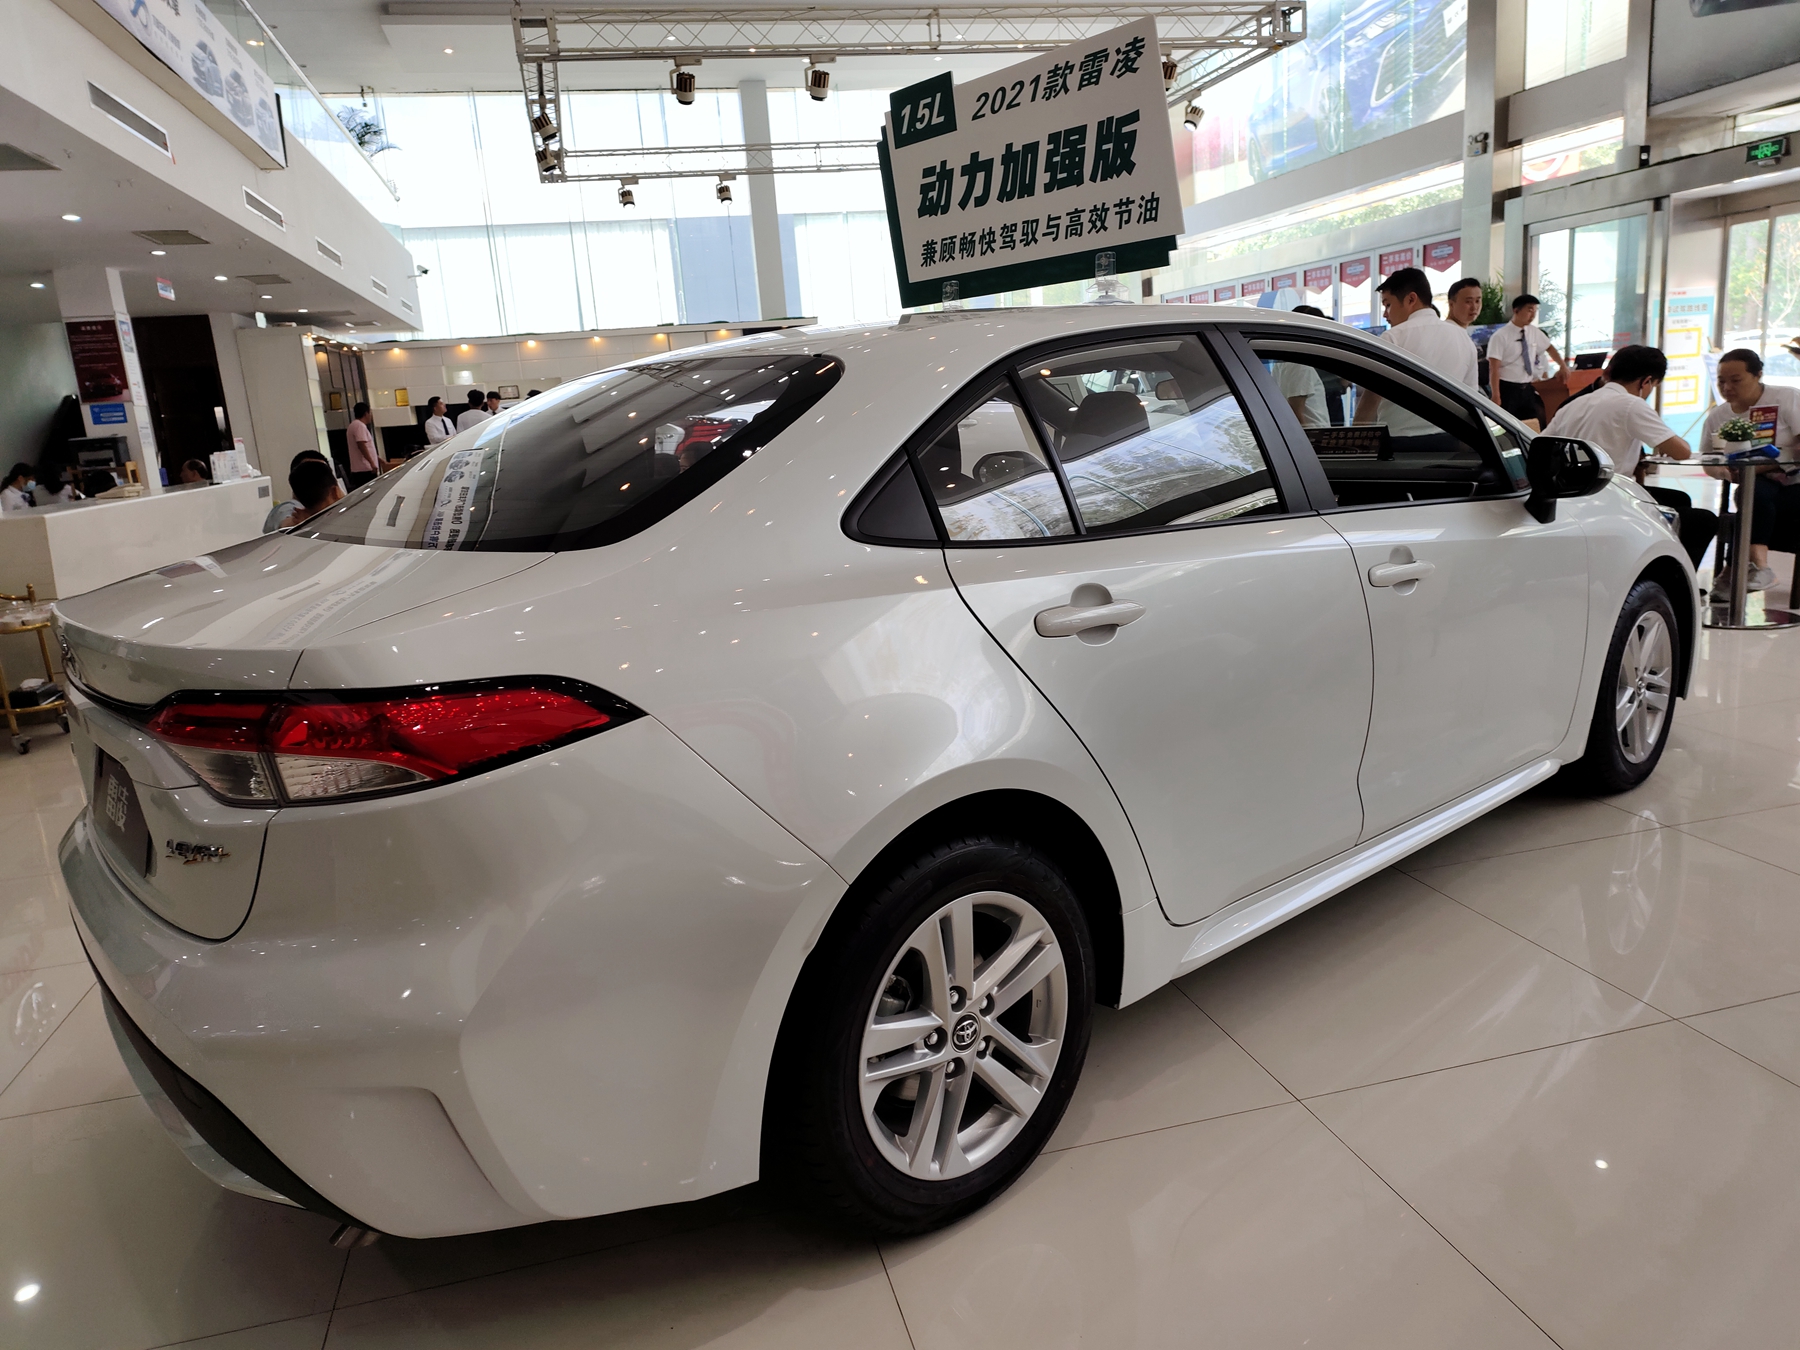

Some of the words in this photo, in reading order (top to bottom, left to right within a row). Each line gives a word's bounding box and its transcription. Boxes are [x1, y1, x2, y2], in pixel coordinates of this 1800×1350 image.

[900, 92, 945, 135] 1.5L
[971, 35, 1147, 121] 2021款雷凌
[917, 109, 1141, 219] 动力加强版
[920, 191, 1161, 268] 兼顾畅快驾驭与高效节油
[106, 774, 129, 832] 雷凌
